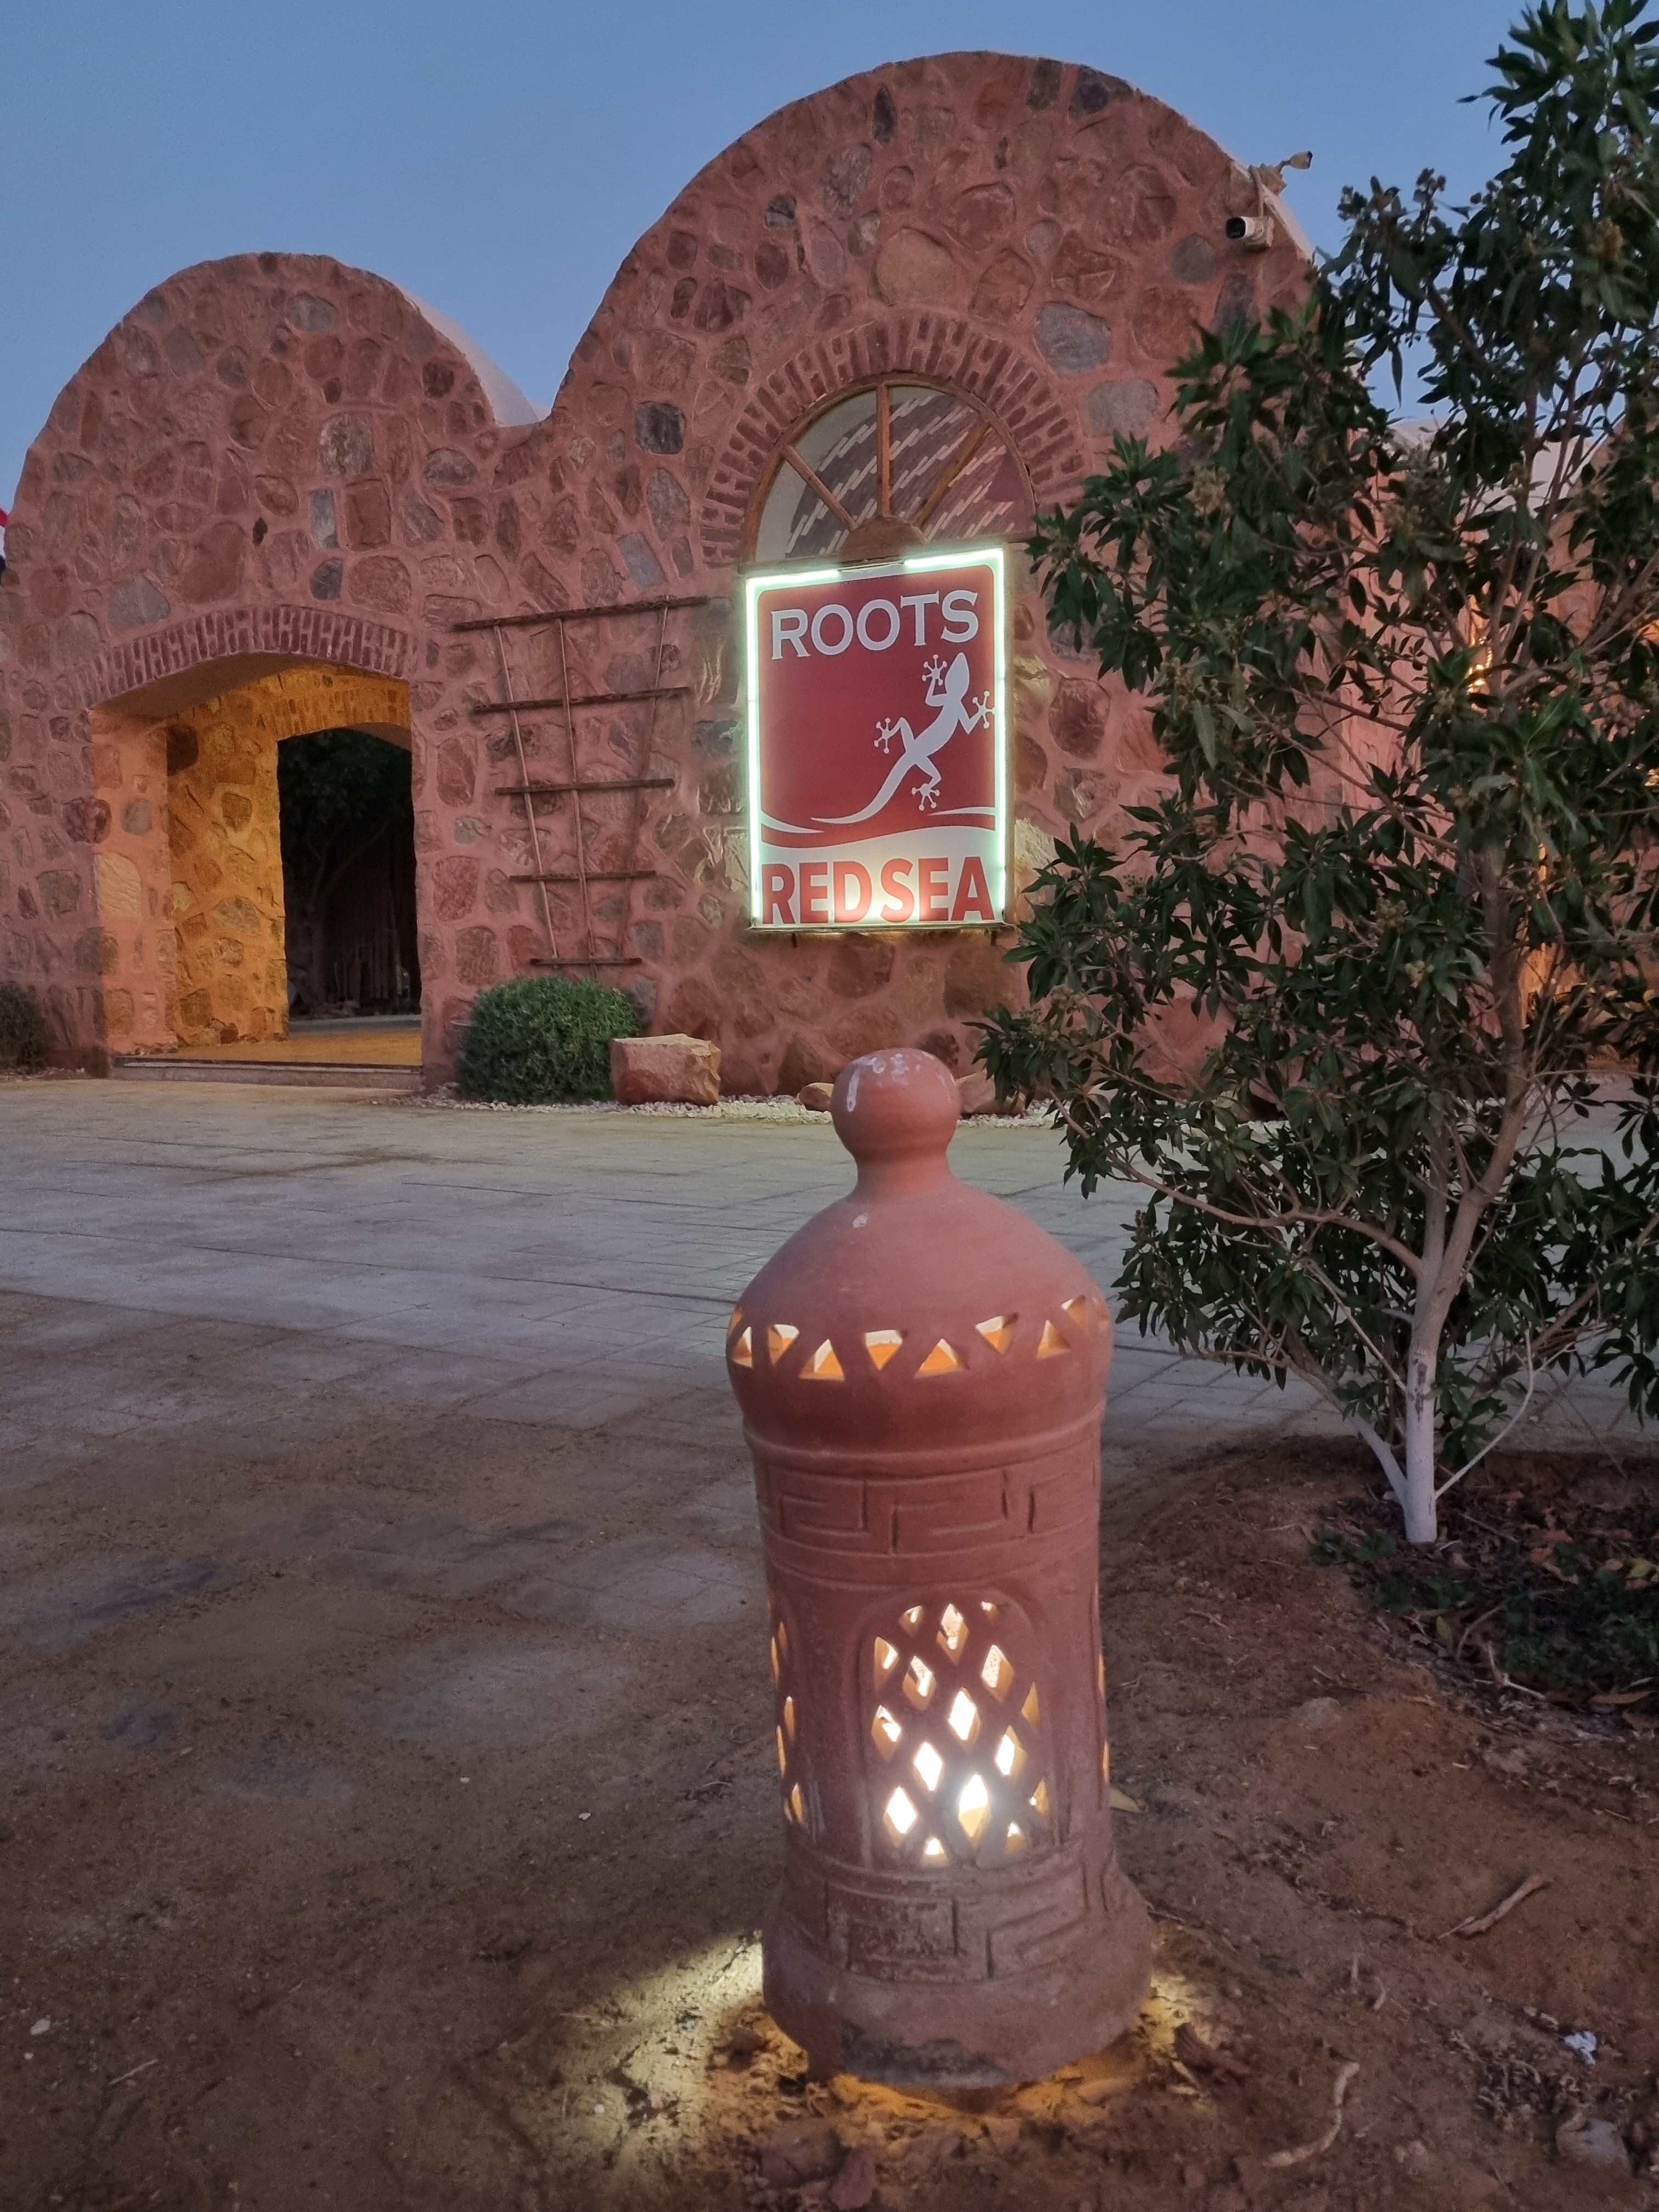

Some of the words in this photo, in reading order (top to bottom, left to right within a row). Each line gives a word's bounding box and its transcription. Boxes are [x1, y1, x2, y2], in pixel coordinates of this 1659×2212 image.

[771, 590, 979, 660] ROOTS
[761, 860, 872, 924] RED
[880, 856, 995, 923] SEA
